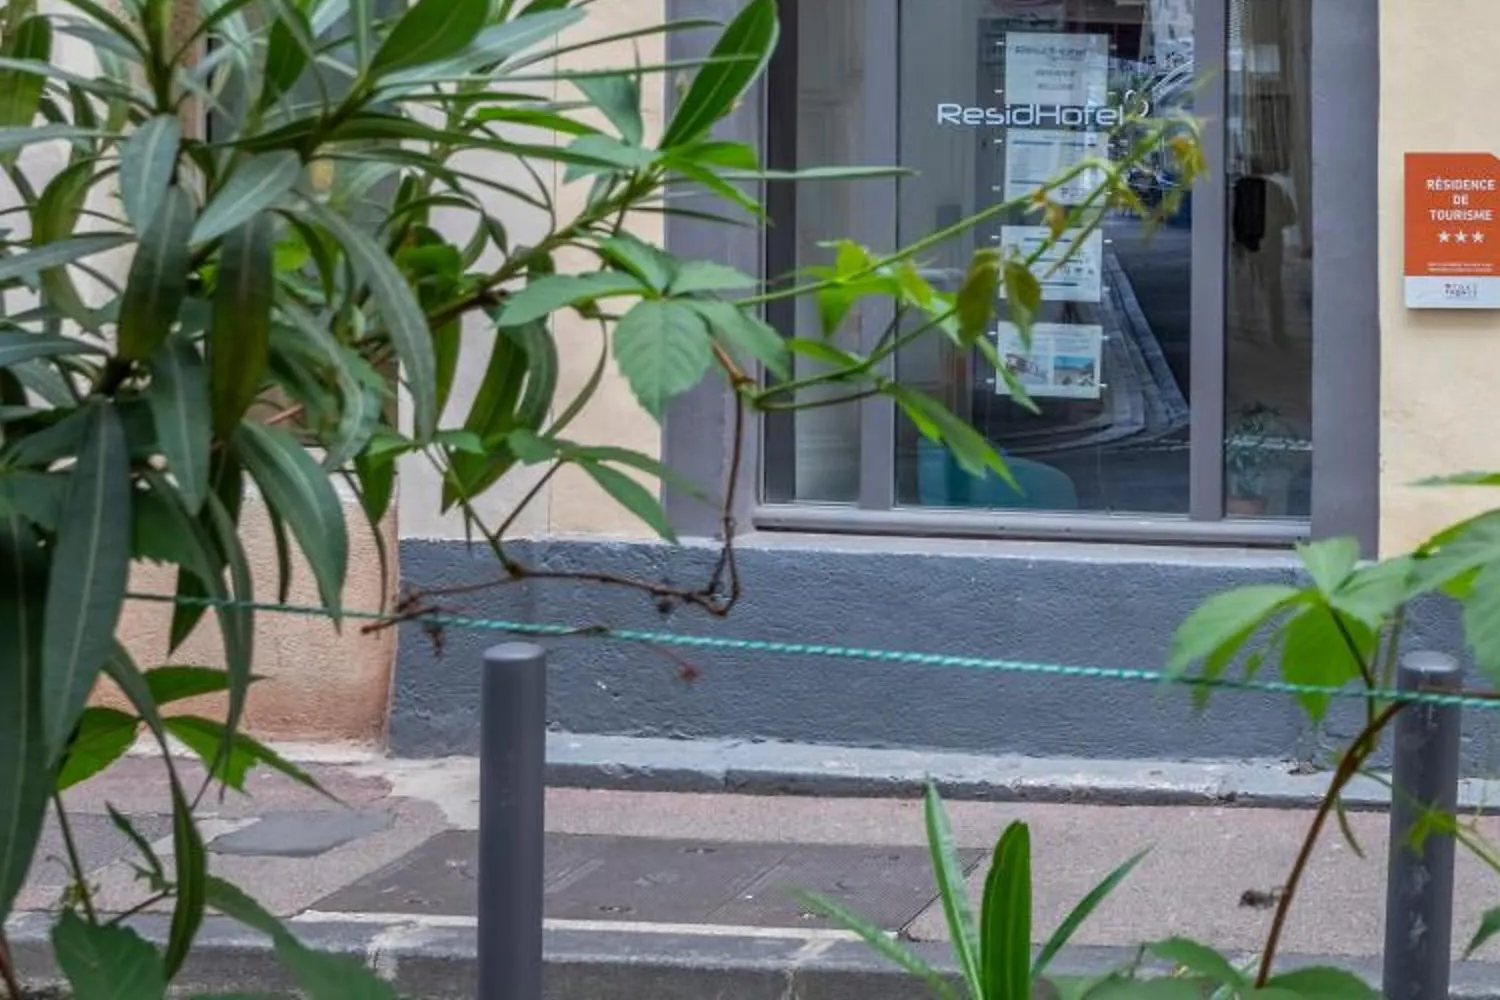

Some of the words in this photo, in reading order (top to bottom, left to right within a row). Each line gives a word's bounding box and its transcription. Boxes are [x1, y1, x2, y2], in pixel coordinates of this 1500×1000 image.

[936, 103, 1124, 126] ResidHotel
[1426, 176, 1496, 191] RÉSIDENCE
[1453, 194, 1469, 205] DE
[1429, 209, 1493, 221] TOURISME
